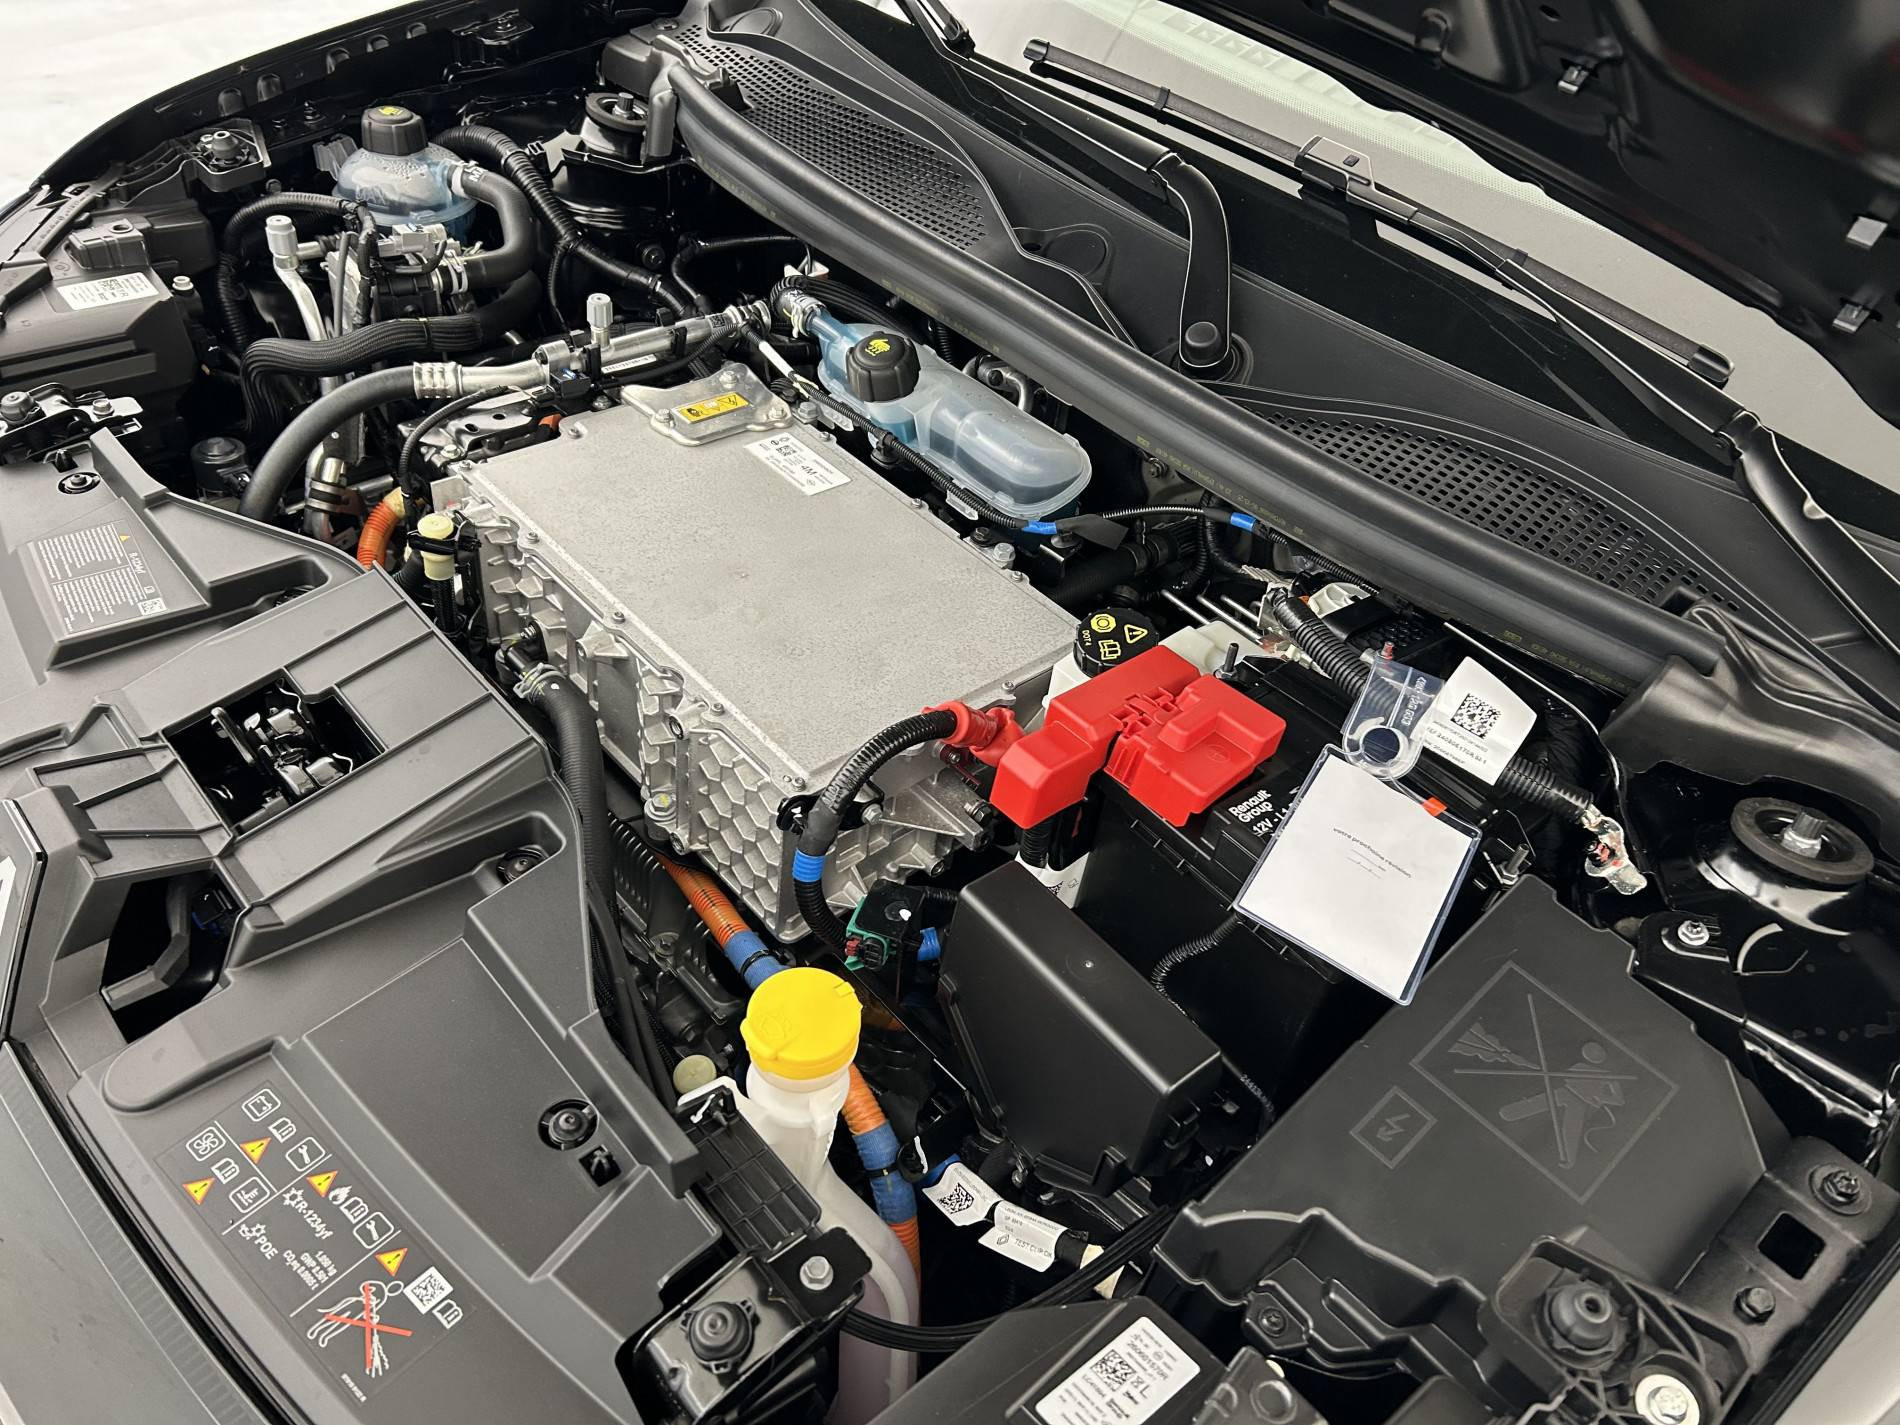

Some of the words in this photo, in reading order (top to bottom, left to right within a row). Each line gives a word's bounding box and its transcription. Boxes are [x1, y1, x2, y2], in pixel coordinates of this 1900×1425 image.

[1082, 630, 1092, 642] DOT
[1228, 790, 1272, 816] Renault
[1238, 801, 1274, 822] Group
[1252, 818, 1273, 835] 12V
[296, 1201, 333, 1239] R-1234yf
[255, 1236, 278, 1259] POE
[1015, 1238, 1030, 1248] TEST
